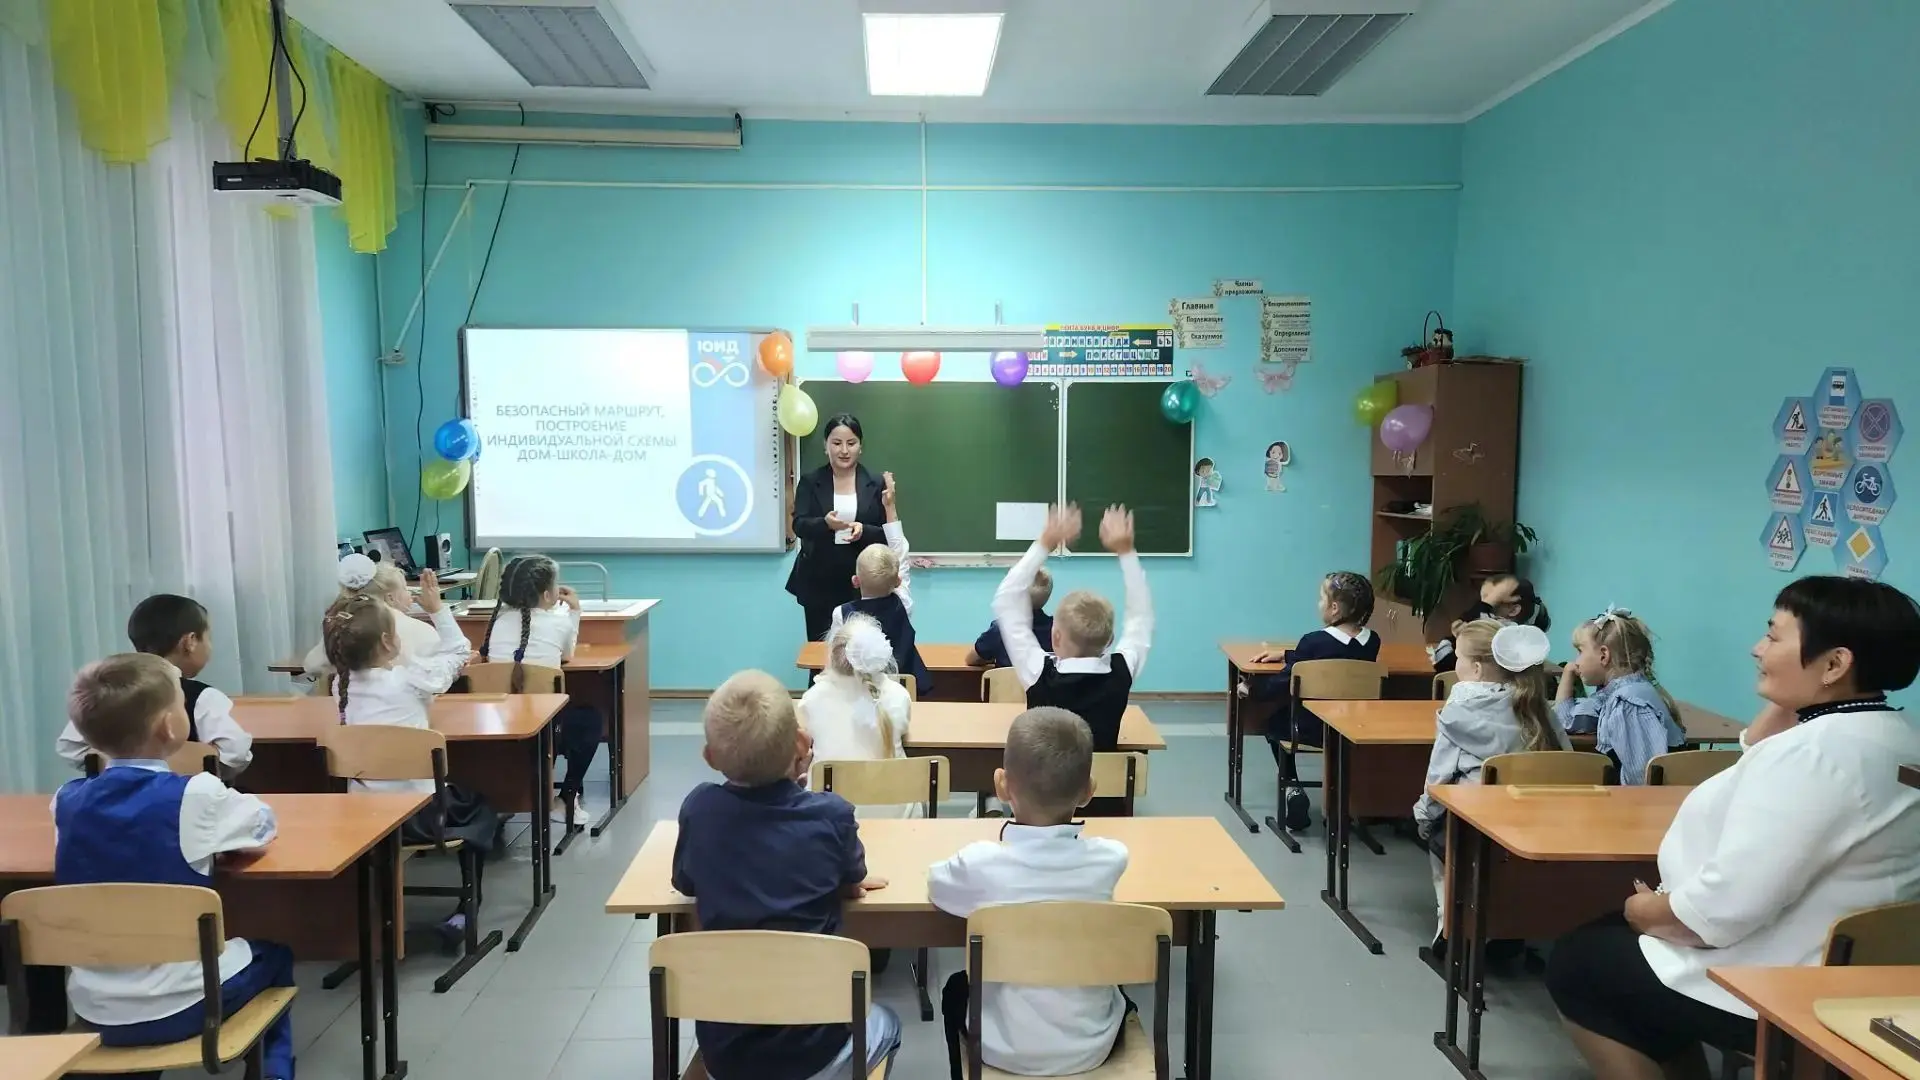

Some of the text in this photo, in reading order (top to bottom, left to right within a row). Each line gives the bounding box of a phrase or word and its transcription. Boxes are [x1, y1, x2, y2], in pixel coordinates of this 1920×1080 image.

[1182, 302, 1214, 310] Главные
[1191, 333, 1223, 341] Сказуемое
[696, 340, 740, 356] ЮИД
[496, 403, 665, 418] БЕЗОПАСНЫЙ МАРШРУТ,
[536, 420, 627, 432] ПОСТРОЕНИЕ
[487, 434, 677, 448] ИНДИВИДУАЛЬНОЙ СХЕМЫ
[517, 449, 647, 462] ДОМ-ШКОЛА-ДОМ
